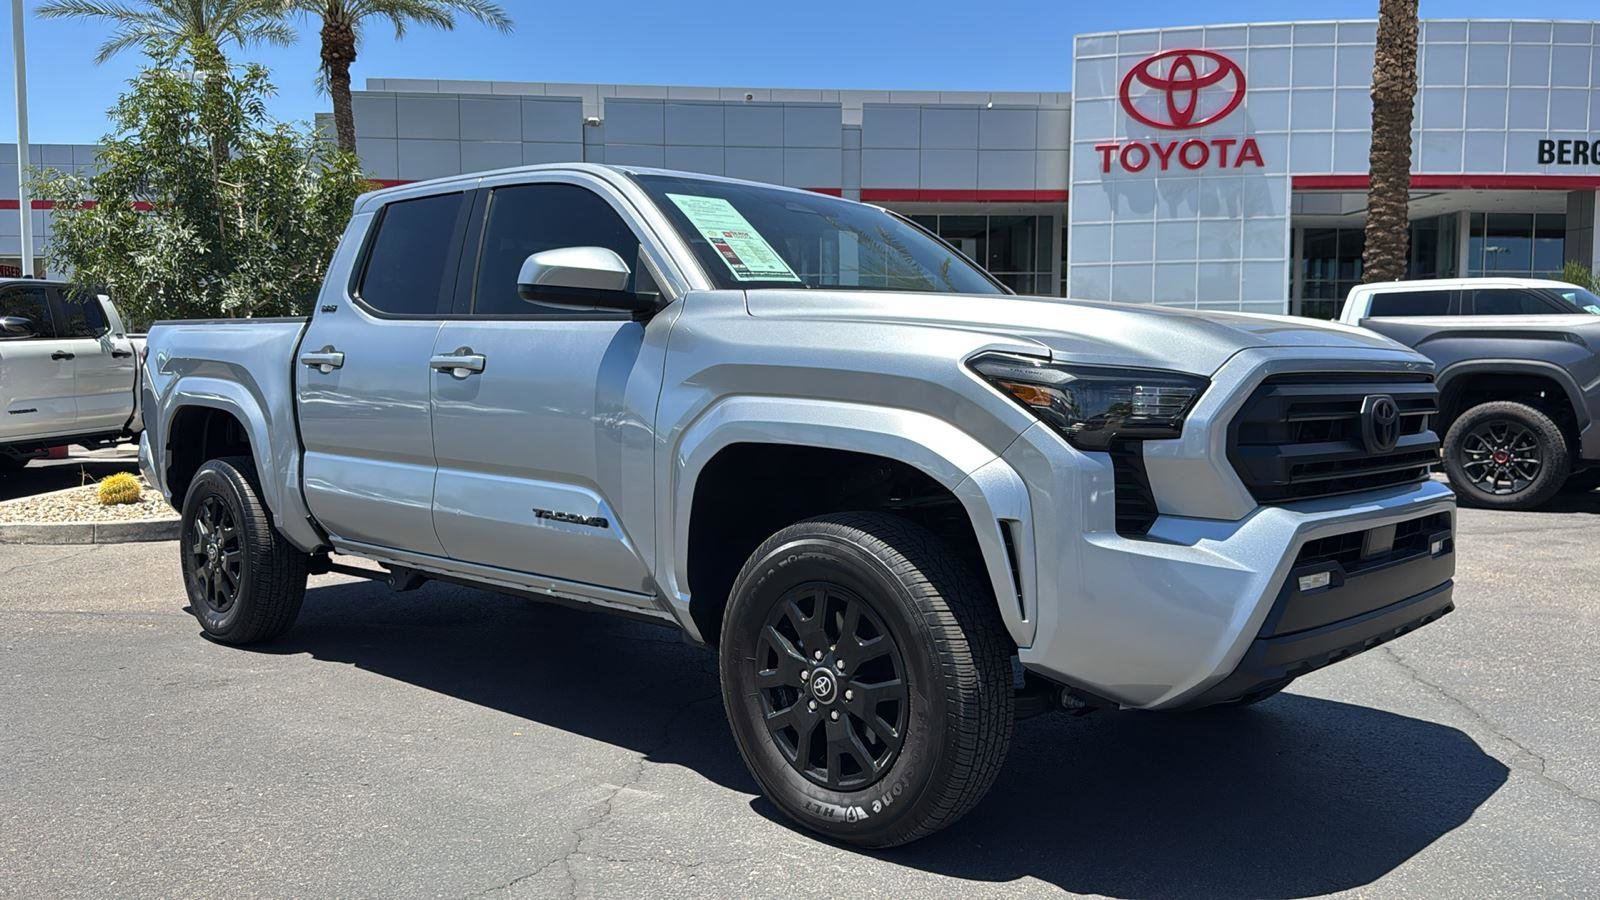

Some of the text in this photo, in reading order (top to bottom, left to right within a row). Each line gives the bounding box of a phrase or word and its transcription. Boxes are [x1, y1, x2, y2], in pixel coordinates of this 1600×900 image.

[1095, 137, 1265, 173] TOYOTA
[1538, 139, 1600, 165] BERG
[532, 508, 609, 529] TACOMA
